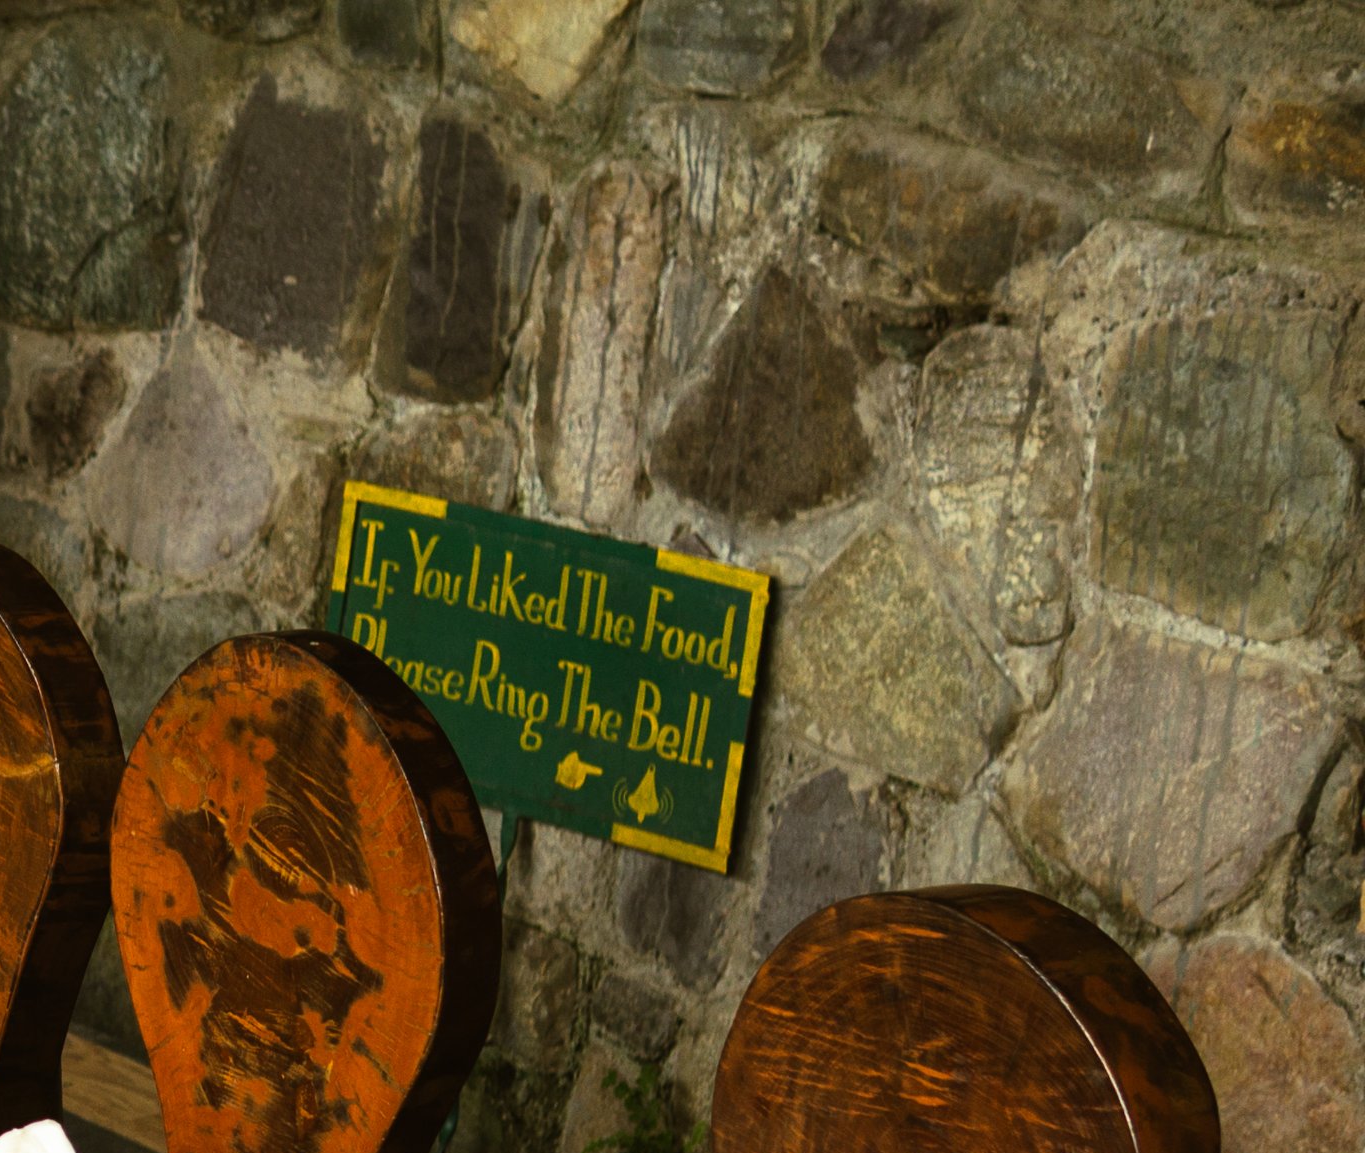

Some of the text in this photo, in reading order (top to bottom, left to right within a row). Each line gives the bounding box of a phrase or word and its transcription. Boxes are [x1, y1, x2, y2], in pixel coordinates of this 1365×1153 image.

[409, 528, 462, 606] You
[577, 567, 635, 646] The
[641, 585, 737, 679] Food,
[466, 639, 549, 751] Ring
[556, 659, 622, 742] The
[628, 679, 714, 770] Bell.
